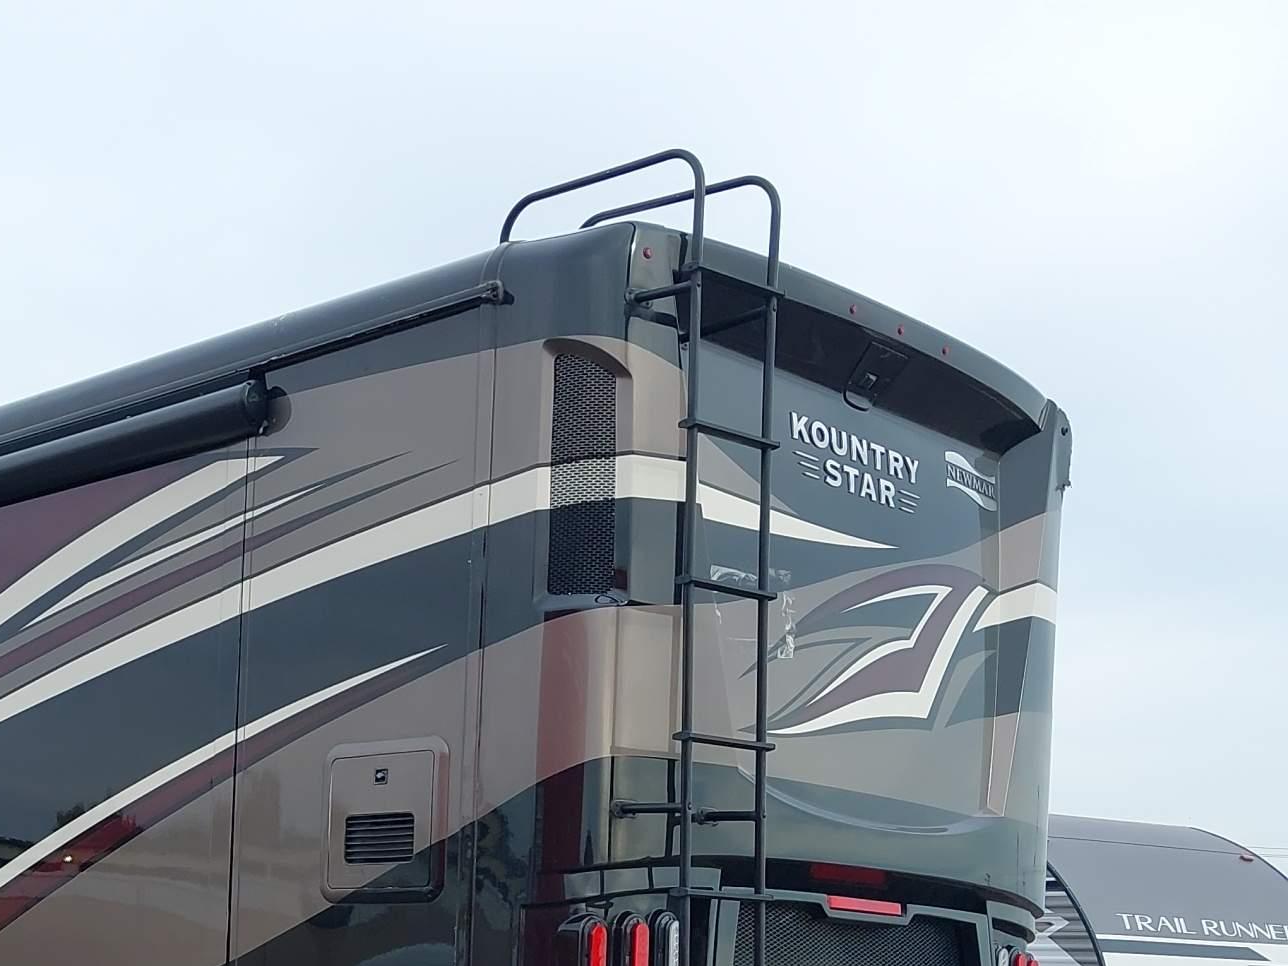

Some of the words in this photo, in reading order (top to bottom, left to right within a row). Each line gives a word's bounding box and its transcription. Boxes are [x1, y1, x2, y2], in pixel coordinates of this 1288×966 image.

[789, 410, 919, 484] KOUNTRY
[823, 459, 896, 508] STAR
[1114, 913, 1197, 934] TRAIL
[1200, 919, 1288, 941] RUNNE
